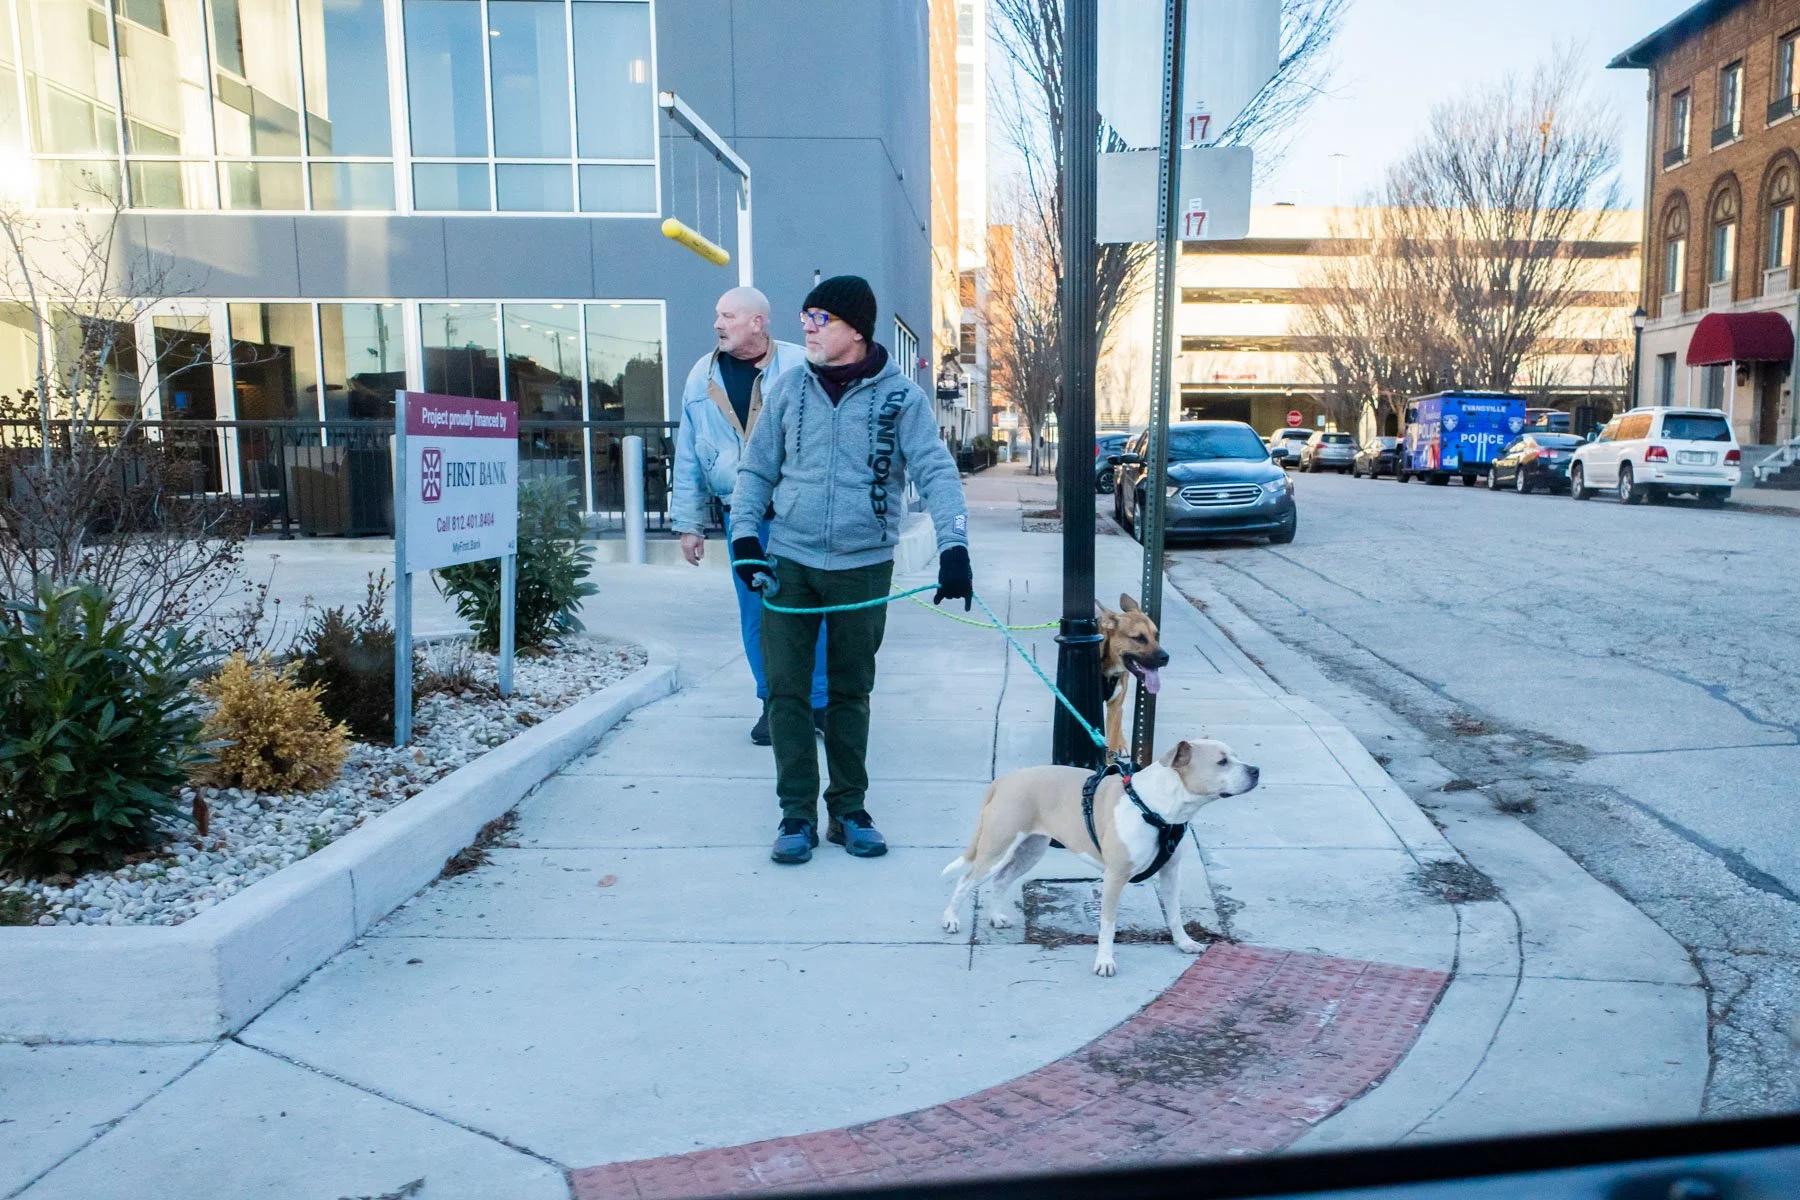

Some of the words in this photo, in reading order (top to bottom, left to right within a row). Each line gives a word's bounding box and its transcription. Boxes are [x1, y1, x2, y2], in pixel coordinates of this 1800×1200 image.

[1189, 114, 1211, 141] 17
[1185, 211, 1207, 237] 17
[422, 407, 448, 429] Project
[449, 410, 474, 431] proudly
[474, 410, 499, 428] financed
[500, 412, 507, 432] by
[1461, 404, 1507, 413] EVANSVILLE
[1460, 433, 1504, 445] POLICE
[446, 461, 476, 487] FIRST
[480, 461, 507, 486] BANK
[436, 516, 450, 533] Call
